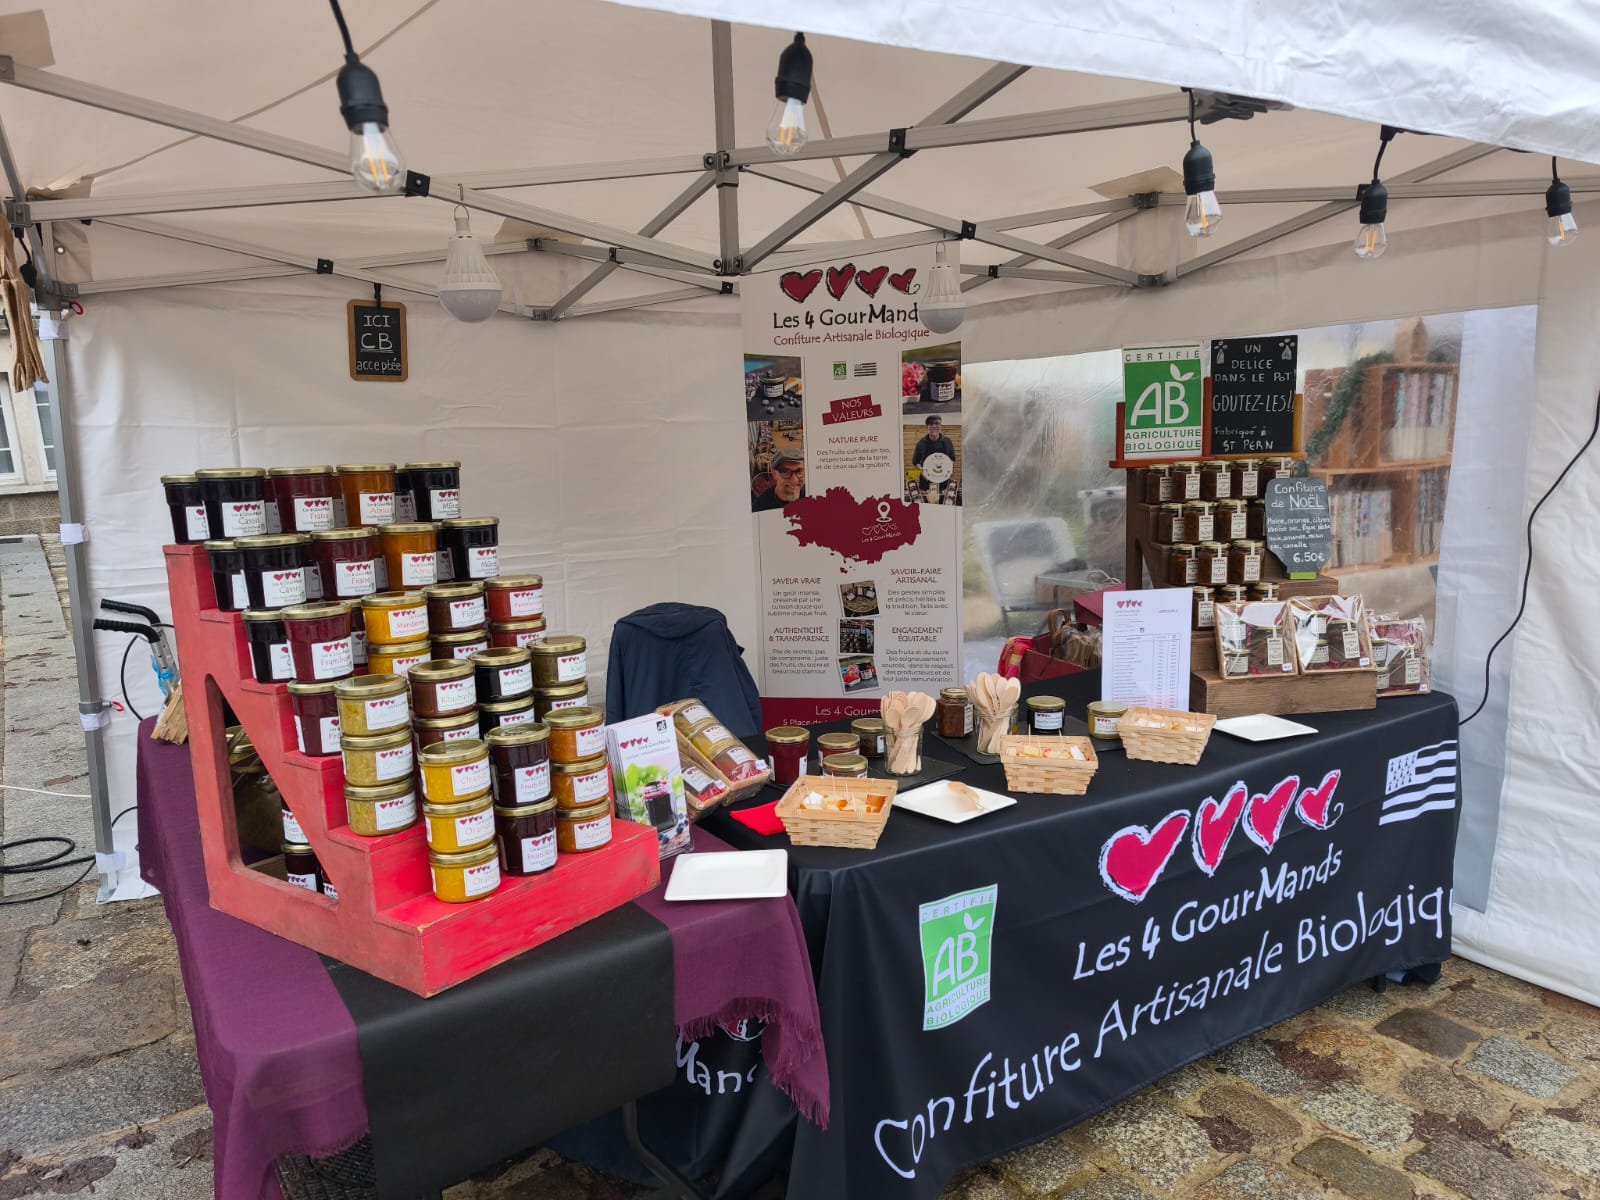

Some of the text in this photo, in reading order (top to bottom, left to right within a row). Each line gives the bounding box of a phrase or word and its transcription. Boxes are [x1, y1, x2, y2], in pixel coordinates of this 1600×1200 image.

[363, 315, 391, 328] ICI
[773, 302, 919, 329] Les 4 GourMand
[361, 332, 393, 350] CB
[774, 328, 930, 346] Confiture Artisanale Biologique
[1244, 344, 1261, 354] UN
[356, 357, 401, 374] acceptée
[1214, 374, 1246, 382] DANS
[1252, 374, 1265, 383] LE
[841, 398, 862, 409] NOS
[1130, 381, 1190, 426] AB
[832, 408, 874, 423] VALEURS
[828, 436, 859, 444] NATURE
[1125, 429, 1201, 441] AGRICULTURE
[1125, 440, 1201, 451] BIOLOGIQUE
[1244, 440, 1274, 451] PERN
[1274, 481, 1326, 494] Confiture
[1289, 494, 1325, 508] NOËL
[890, 568, 942, 576] SAVOIR-FAIRE
[896, 576, 938, 584] ARTISANAL
[774, 626, 824, 634] AUTHENTICITÉ
[898, 634, 937, 642] ÉQUITABLE
[816, 705, 881, 716] Les 4 Gourm
[1072, 843, 1343, 981] Les 4 GourMands
[933, 932, 979, 997] AB
[927, 976, 989, 1014] AGRICULTURE
[926, 988, 989, 1025] BIOLOGIQUE
[874, 884, 1453, 1179] Confiture Artisanale Biologiq
